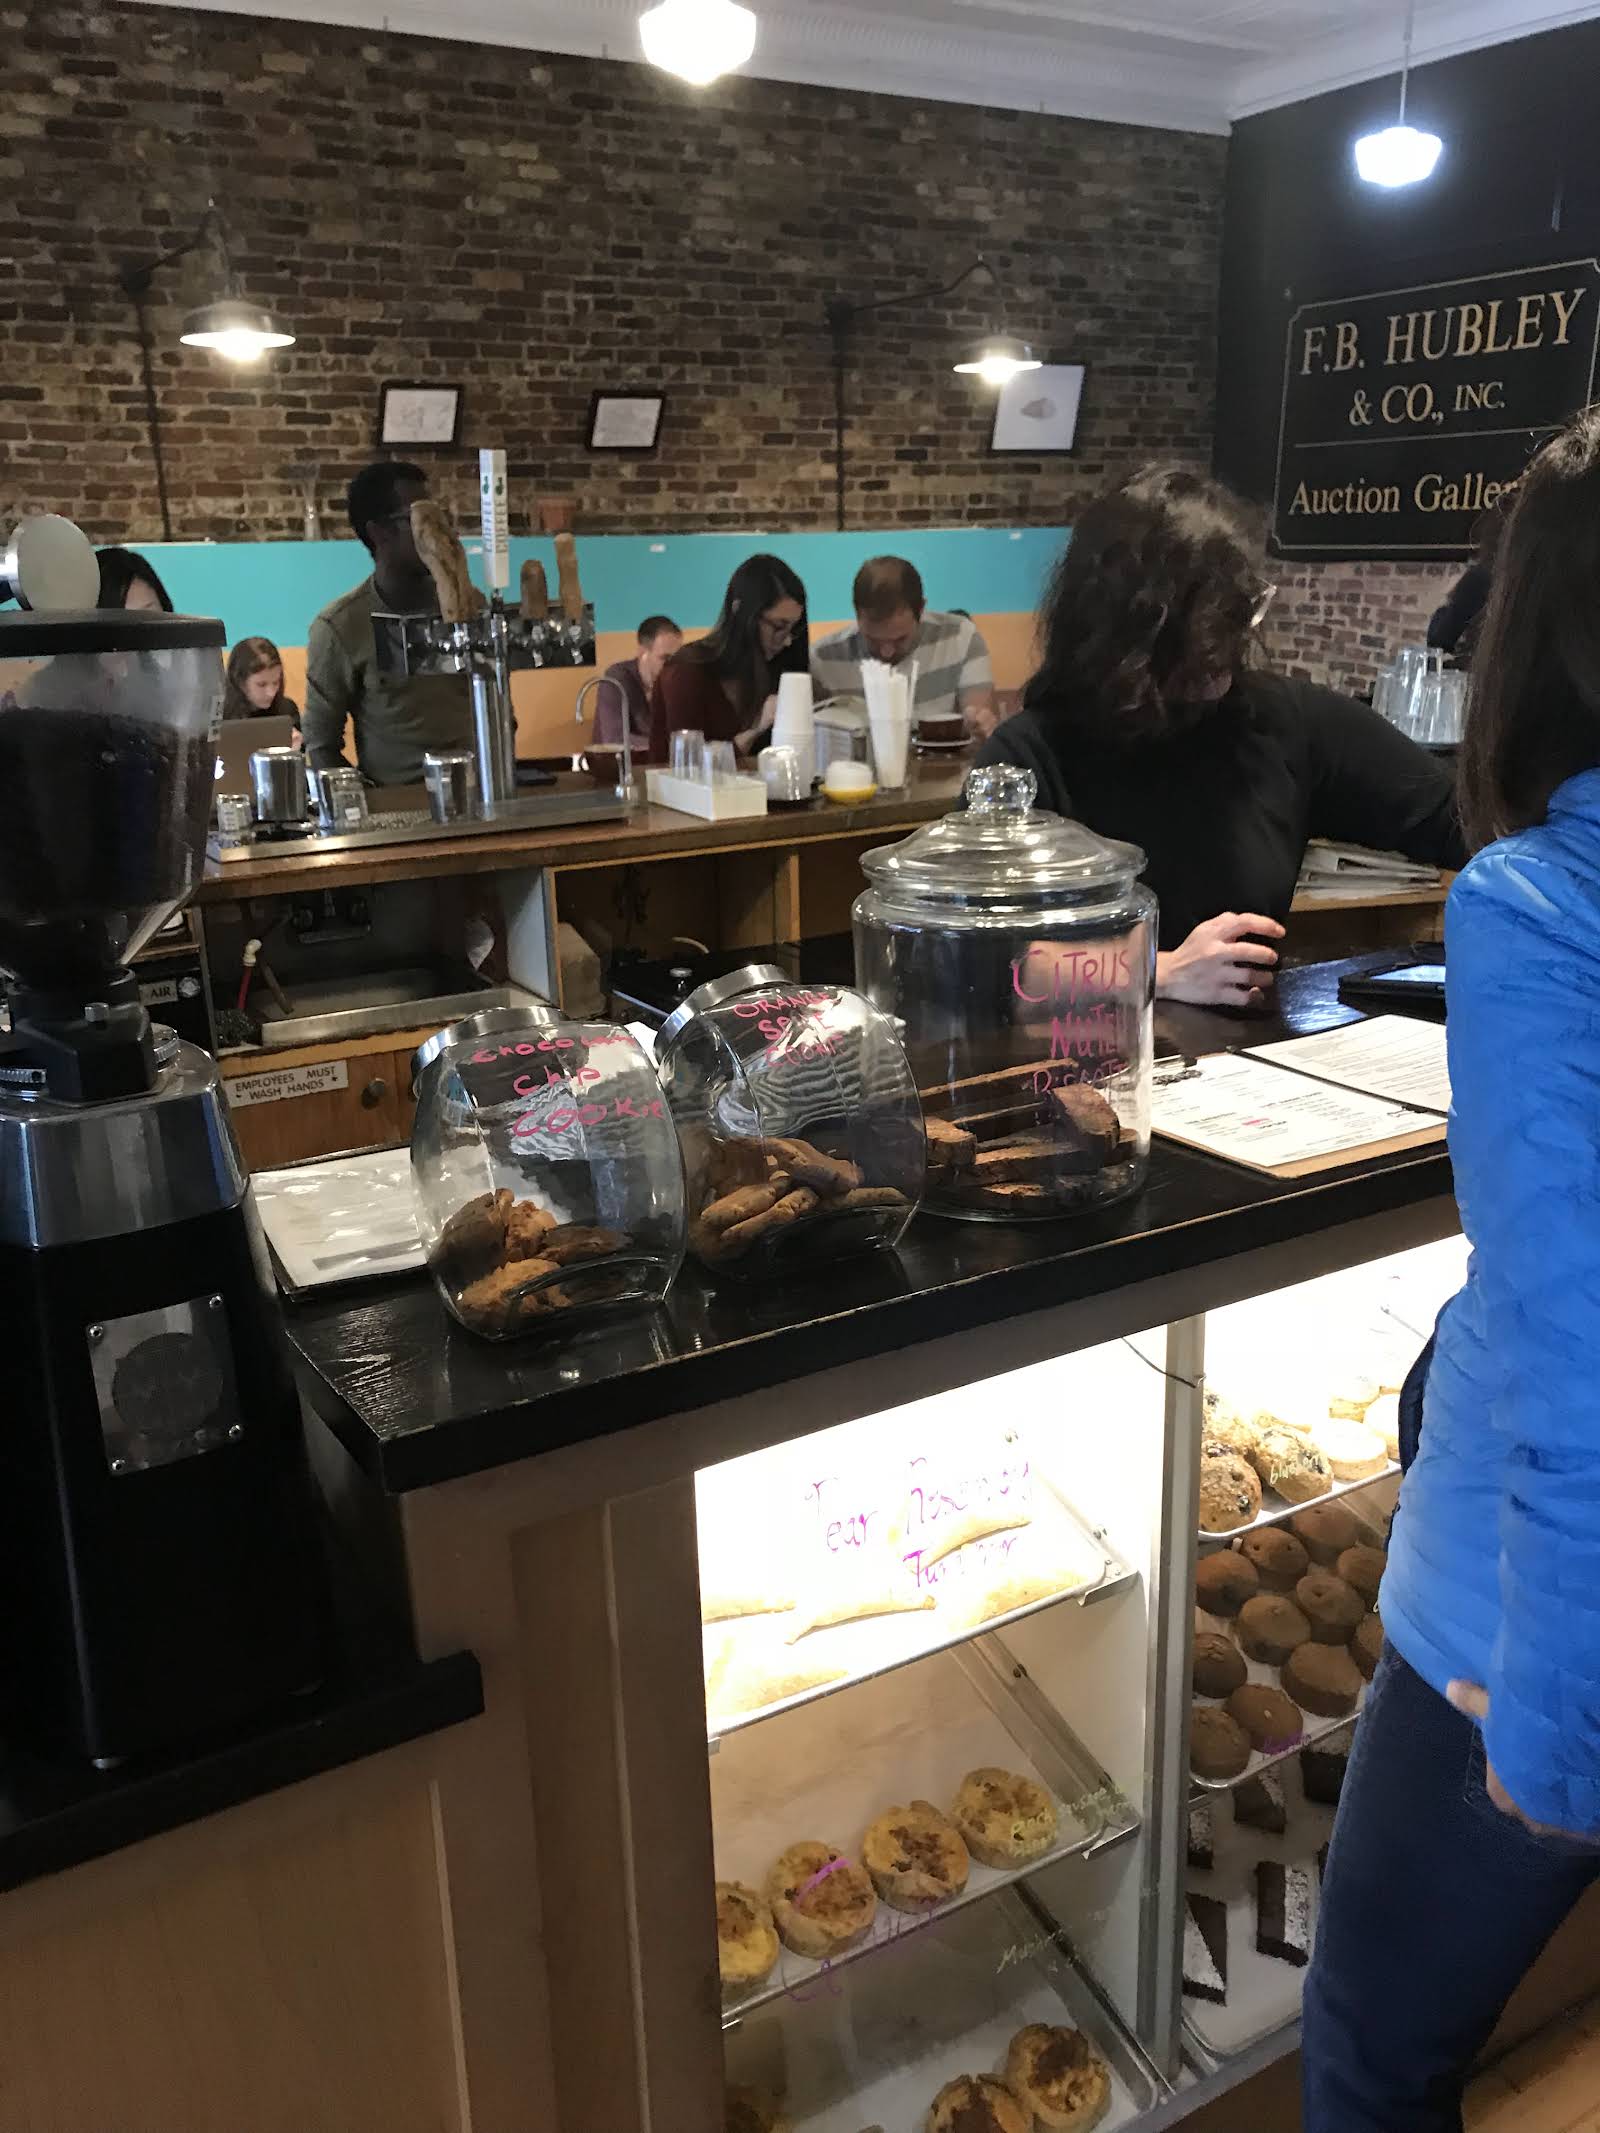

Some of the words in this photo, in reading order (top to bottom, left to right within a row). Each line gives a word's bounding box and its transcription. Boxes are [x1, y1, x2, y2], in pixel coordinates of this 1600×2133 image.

[1300, 321, 1365, 375] F.B.
[1383, 288, 1587, 366] HUBLEY
[1349, 389, 1373, 426] &
[1454, 381, 1506, 412] INC.
[1288, 477, 1400, 515] Auction
[1414, 472, 1500, 512] Galle
[151, 986, 172, 998] AIR
[235, 1073, 295, 1091] EMPLOYEES
[306, 1066, 336, 1079] MUST
[248, 1088, 282, 1100] WASH
[287, 1080, 324, 1093] HANDS
